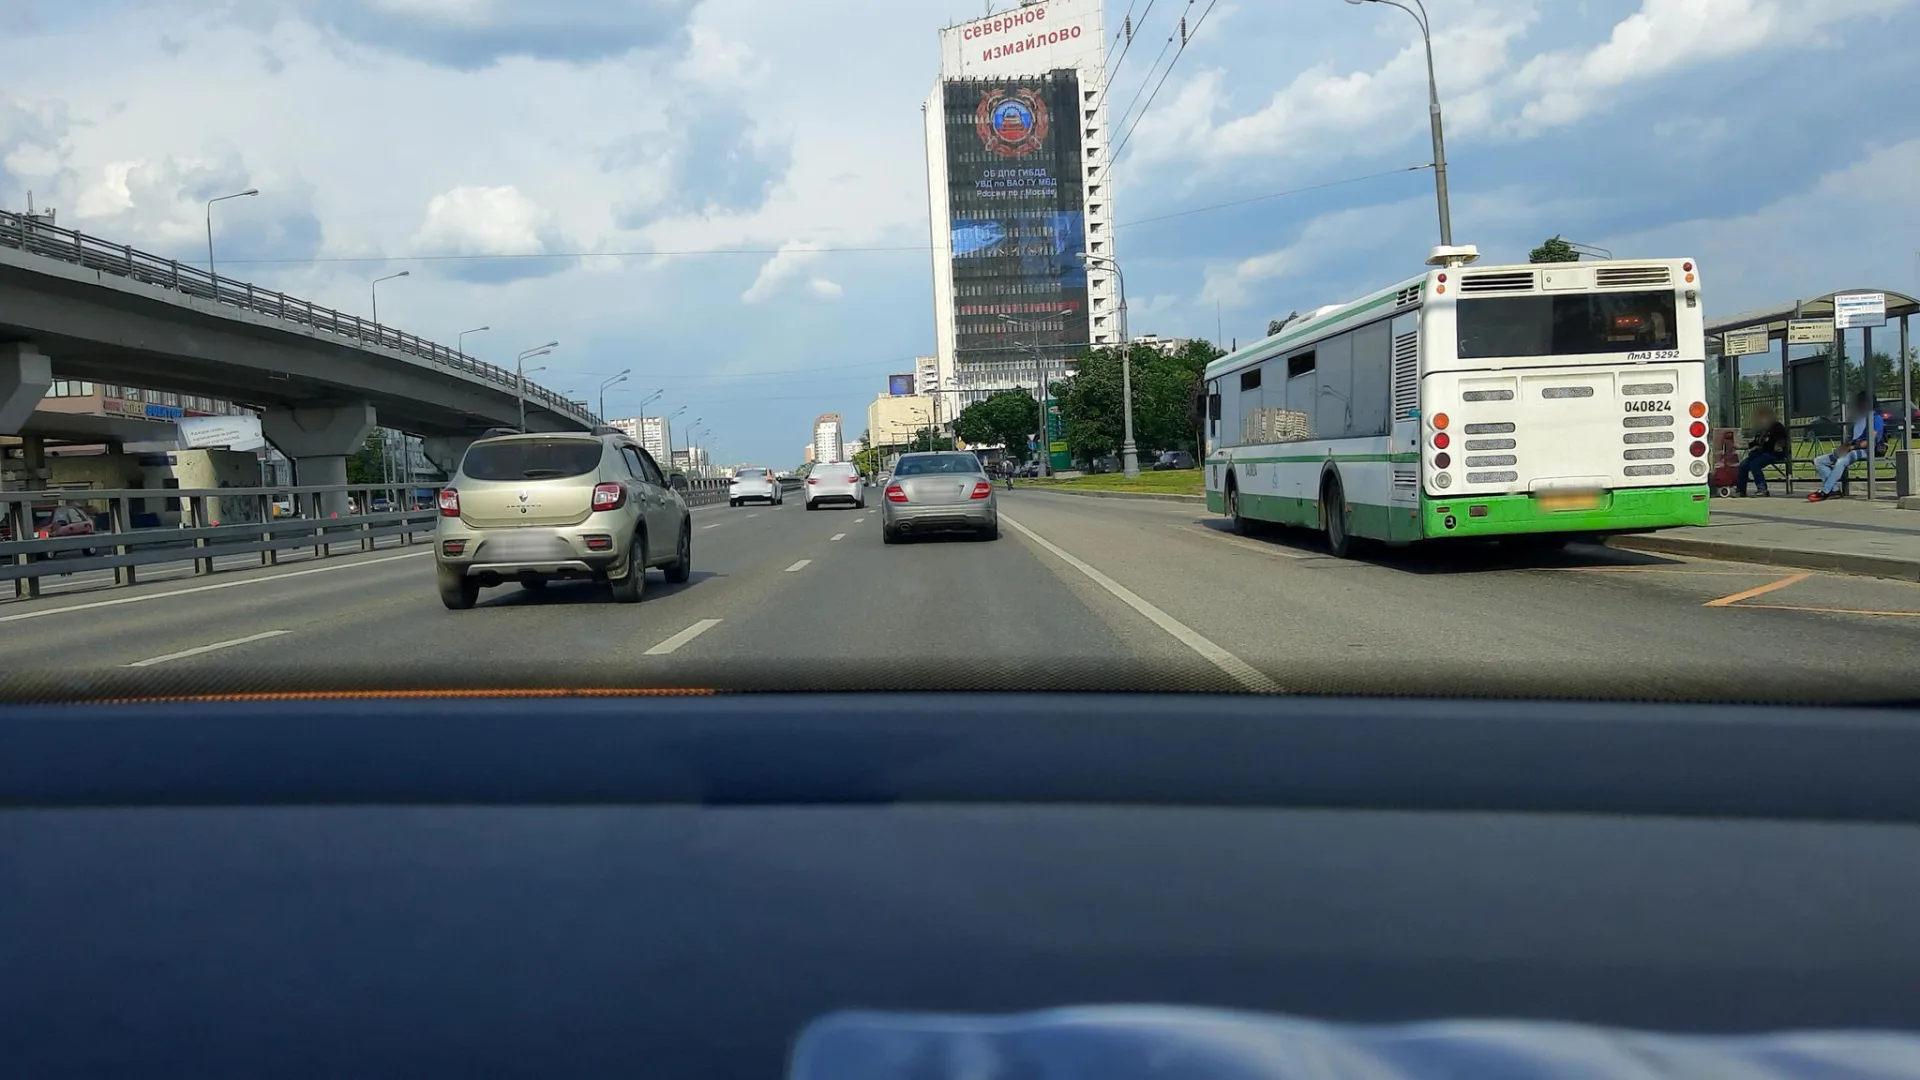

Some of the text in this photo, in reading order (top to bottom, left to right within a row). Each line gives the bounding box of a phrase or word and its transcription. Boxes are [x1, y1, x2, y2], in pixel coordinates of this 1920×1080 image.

[964, 8, 1045, 40] северное
[983, 26, 1081, 61] измайлово
[983, 168, 1046, 178] ОБ ДПС ГИБДД
[975, 180, 992, 188] УВД
[1006, 179, 1025, 187] ВАО
[1038, 178, 1057, 186] МВД
[976, 189, 1006, 198] России
[1655, 350, 1680, 359] 5292
[1624, 400, 1671, 412] 040824
